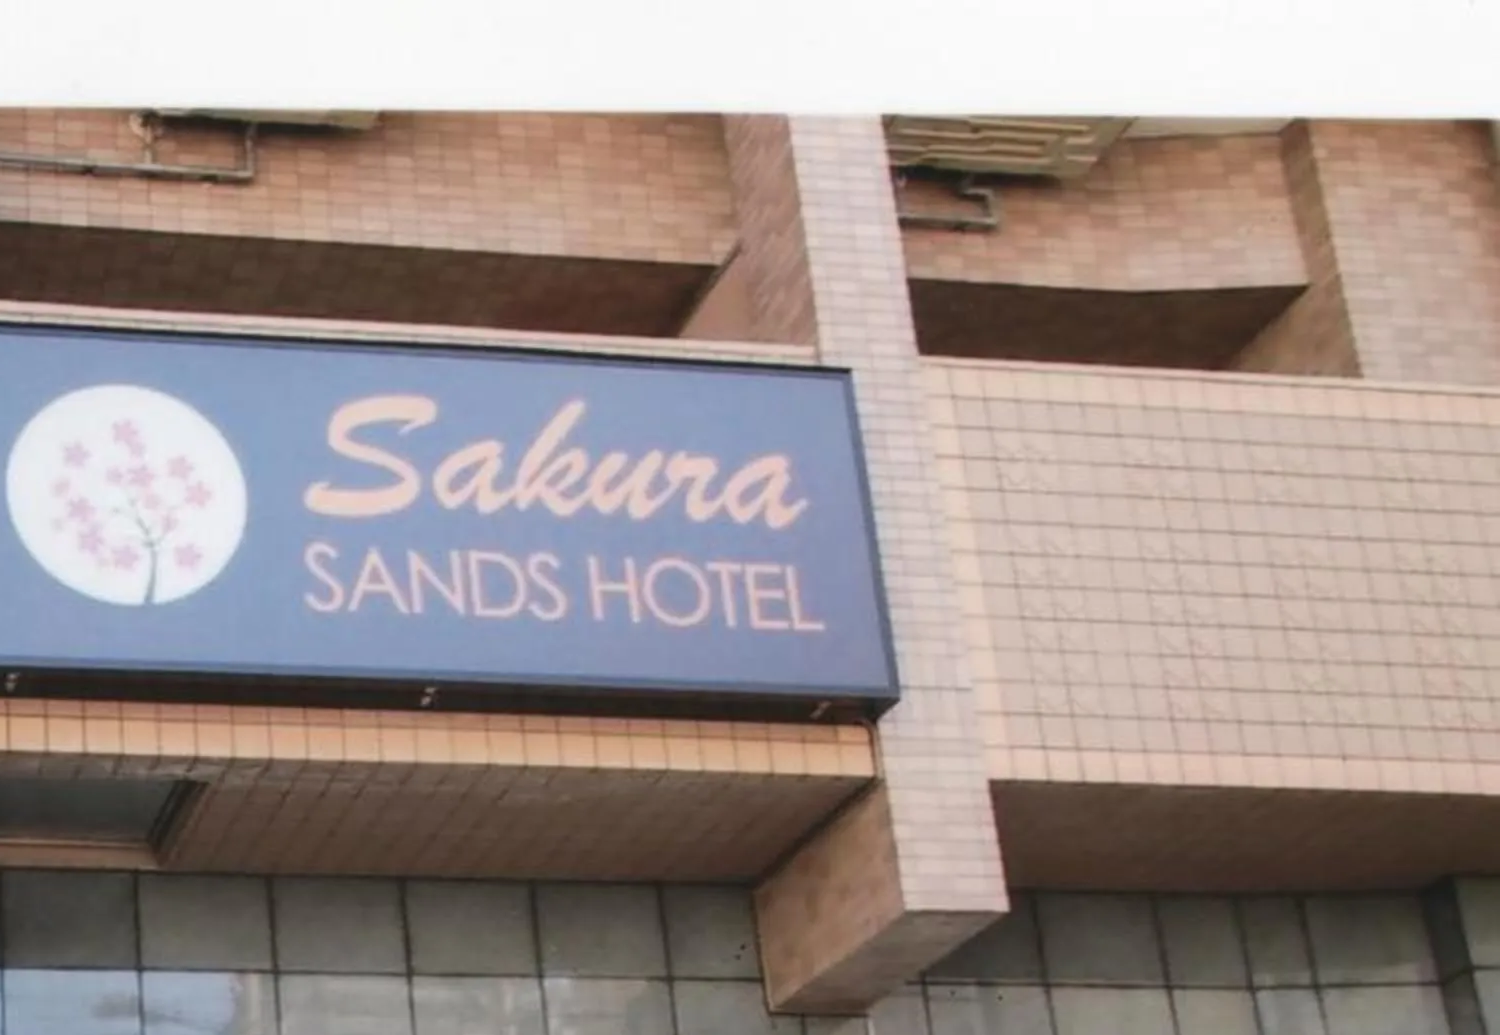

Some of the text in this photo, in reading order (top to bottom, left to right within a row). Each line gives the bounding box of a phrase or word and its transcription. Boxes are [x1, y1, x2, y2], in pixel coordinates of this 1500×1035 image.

[304, 395, 809, 528] Sakura
[304, 541, 826, 631] SANDS HOTEL
